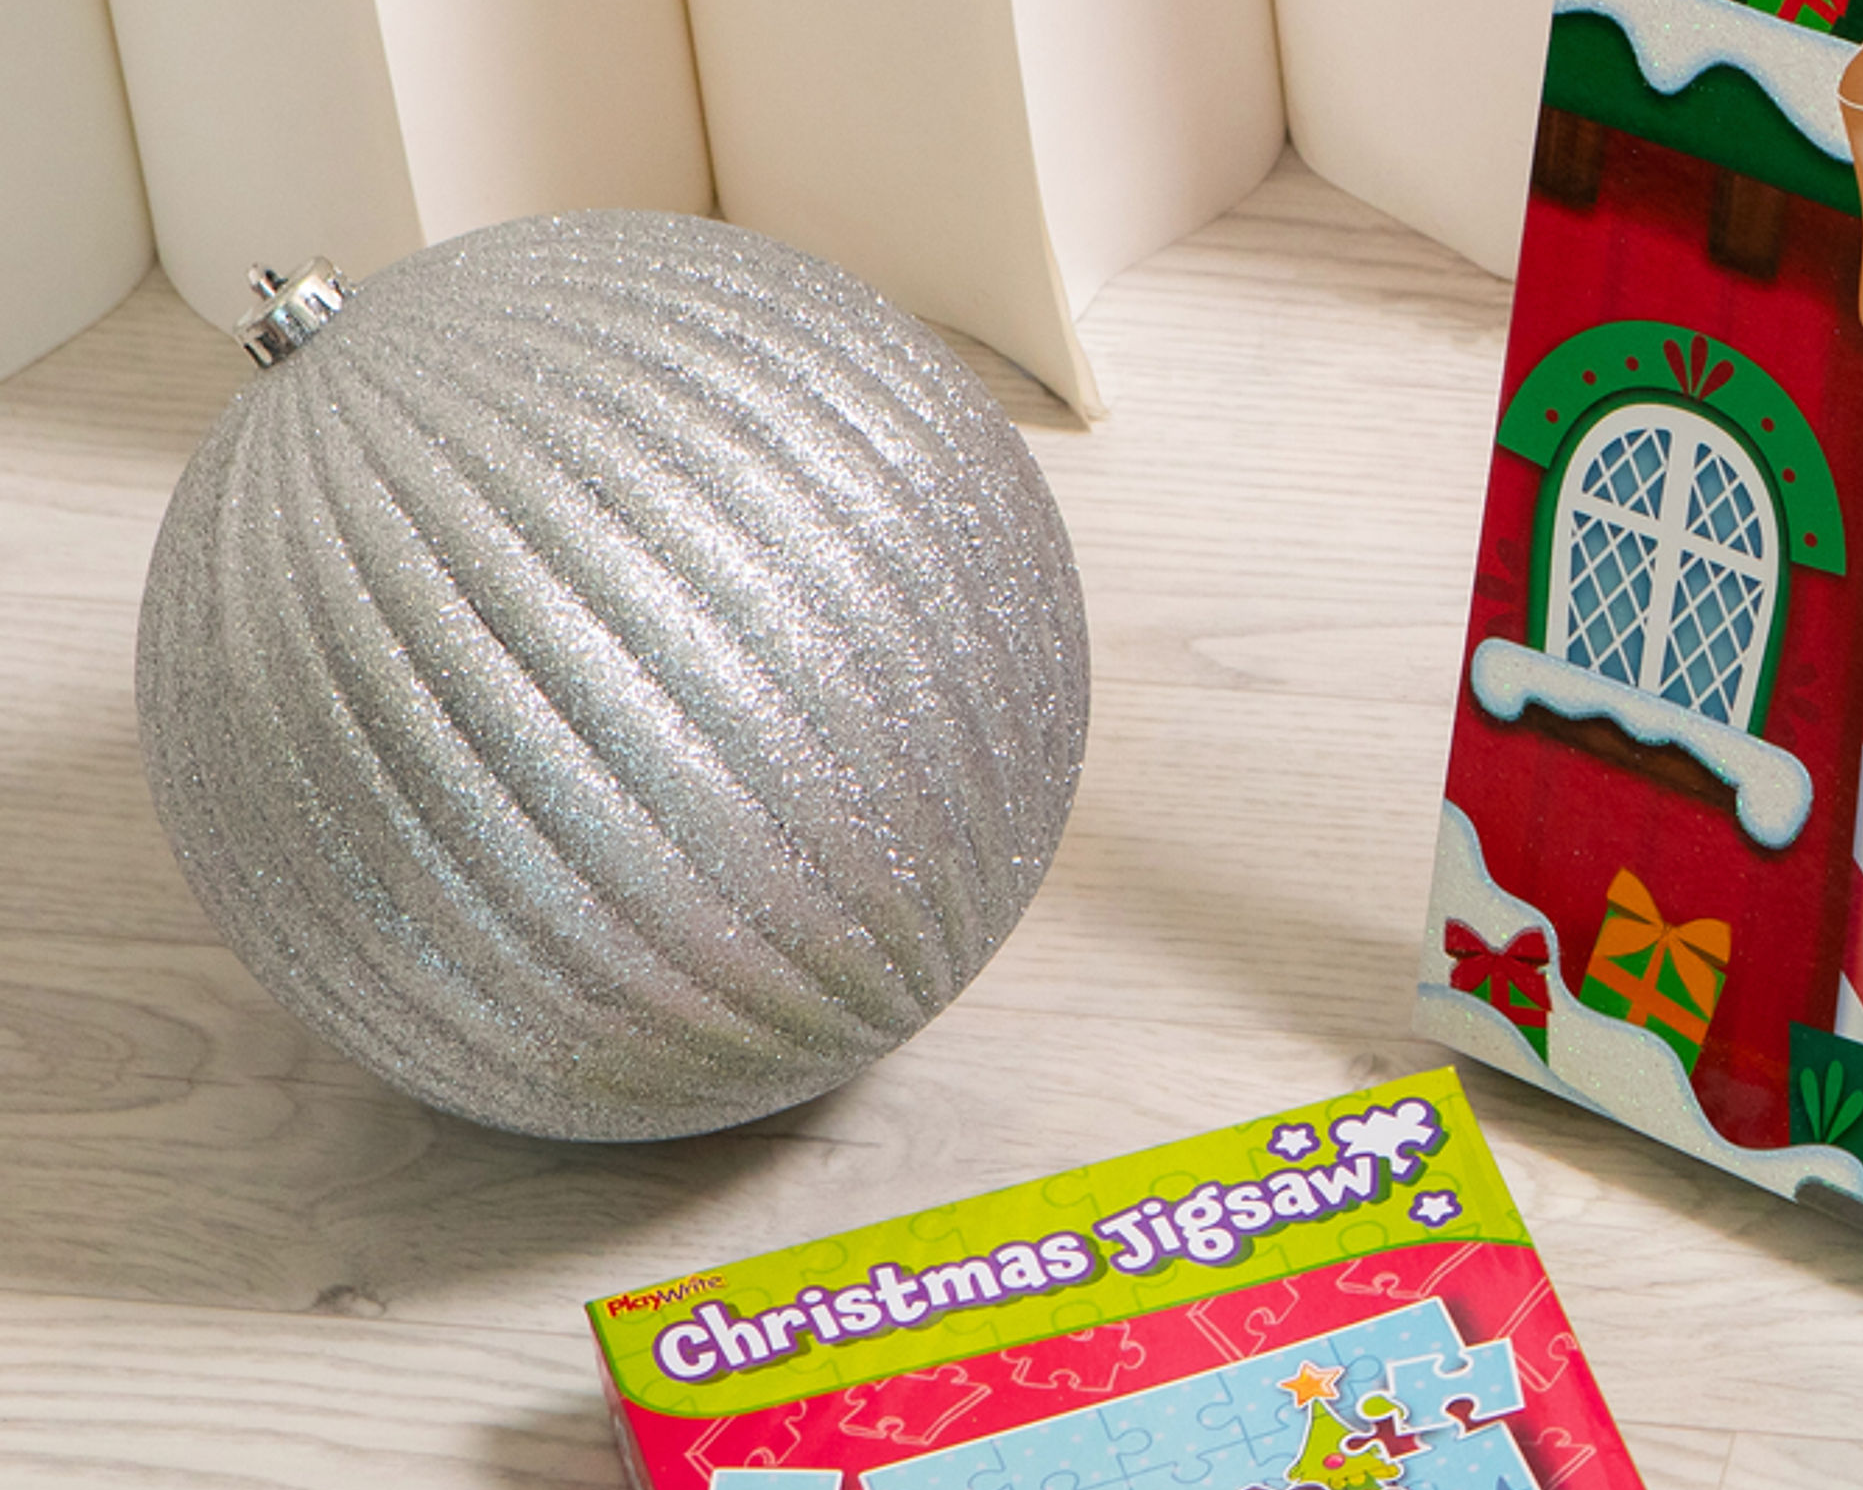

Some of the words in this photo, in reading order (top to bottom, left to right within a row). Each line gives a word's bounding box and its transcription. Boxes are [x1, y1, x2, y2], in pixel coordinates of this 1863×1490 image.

[605, 1274, 727, 1318] PlayWrite
[656, 1235, 1090, 1380] Christmas
[1098, 1154, 1375, 1272] Jigsaw
